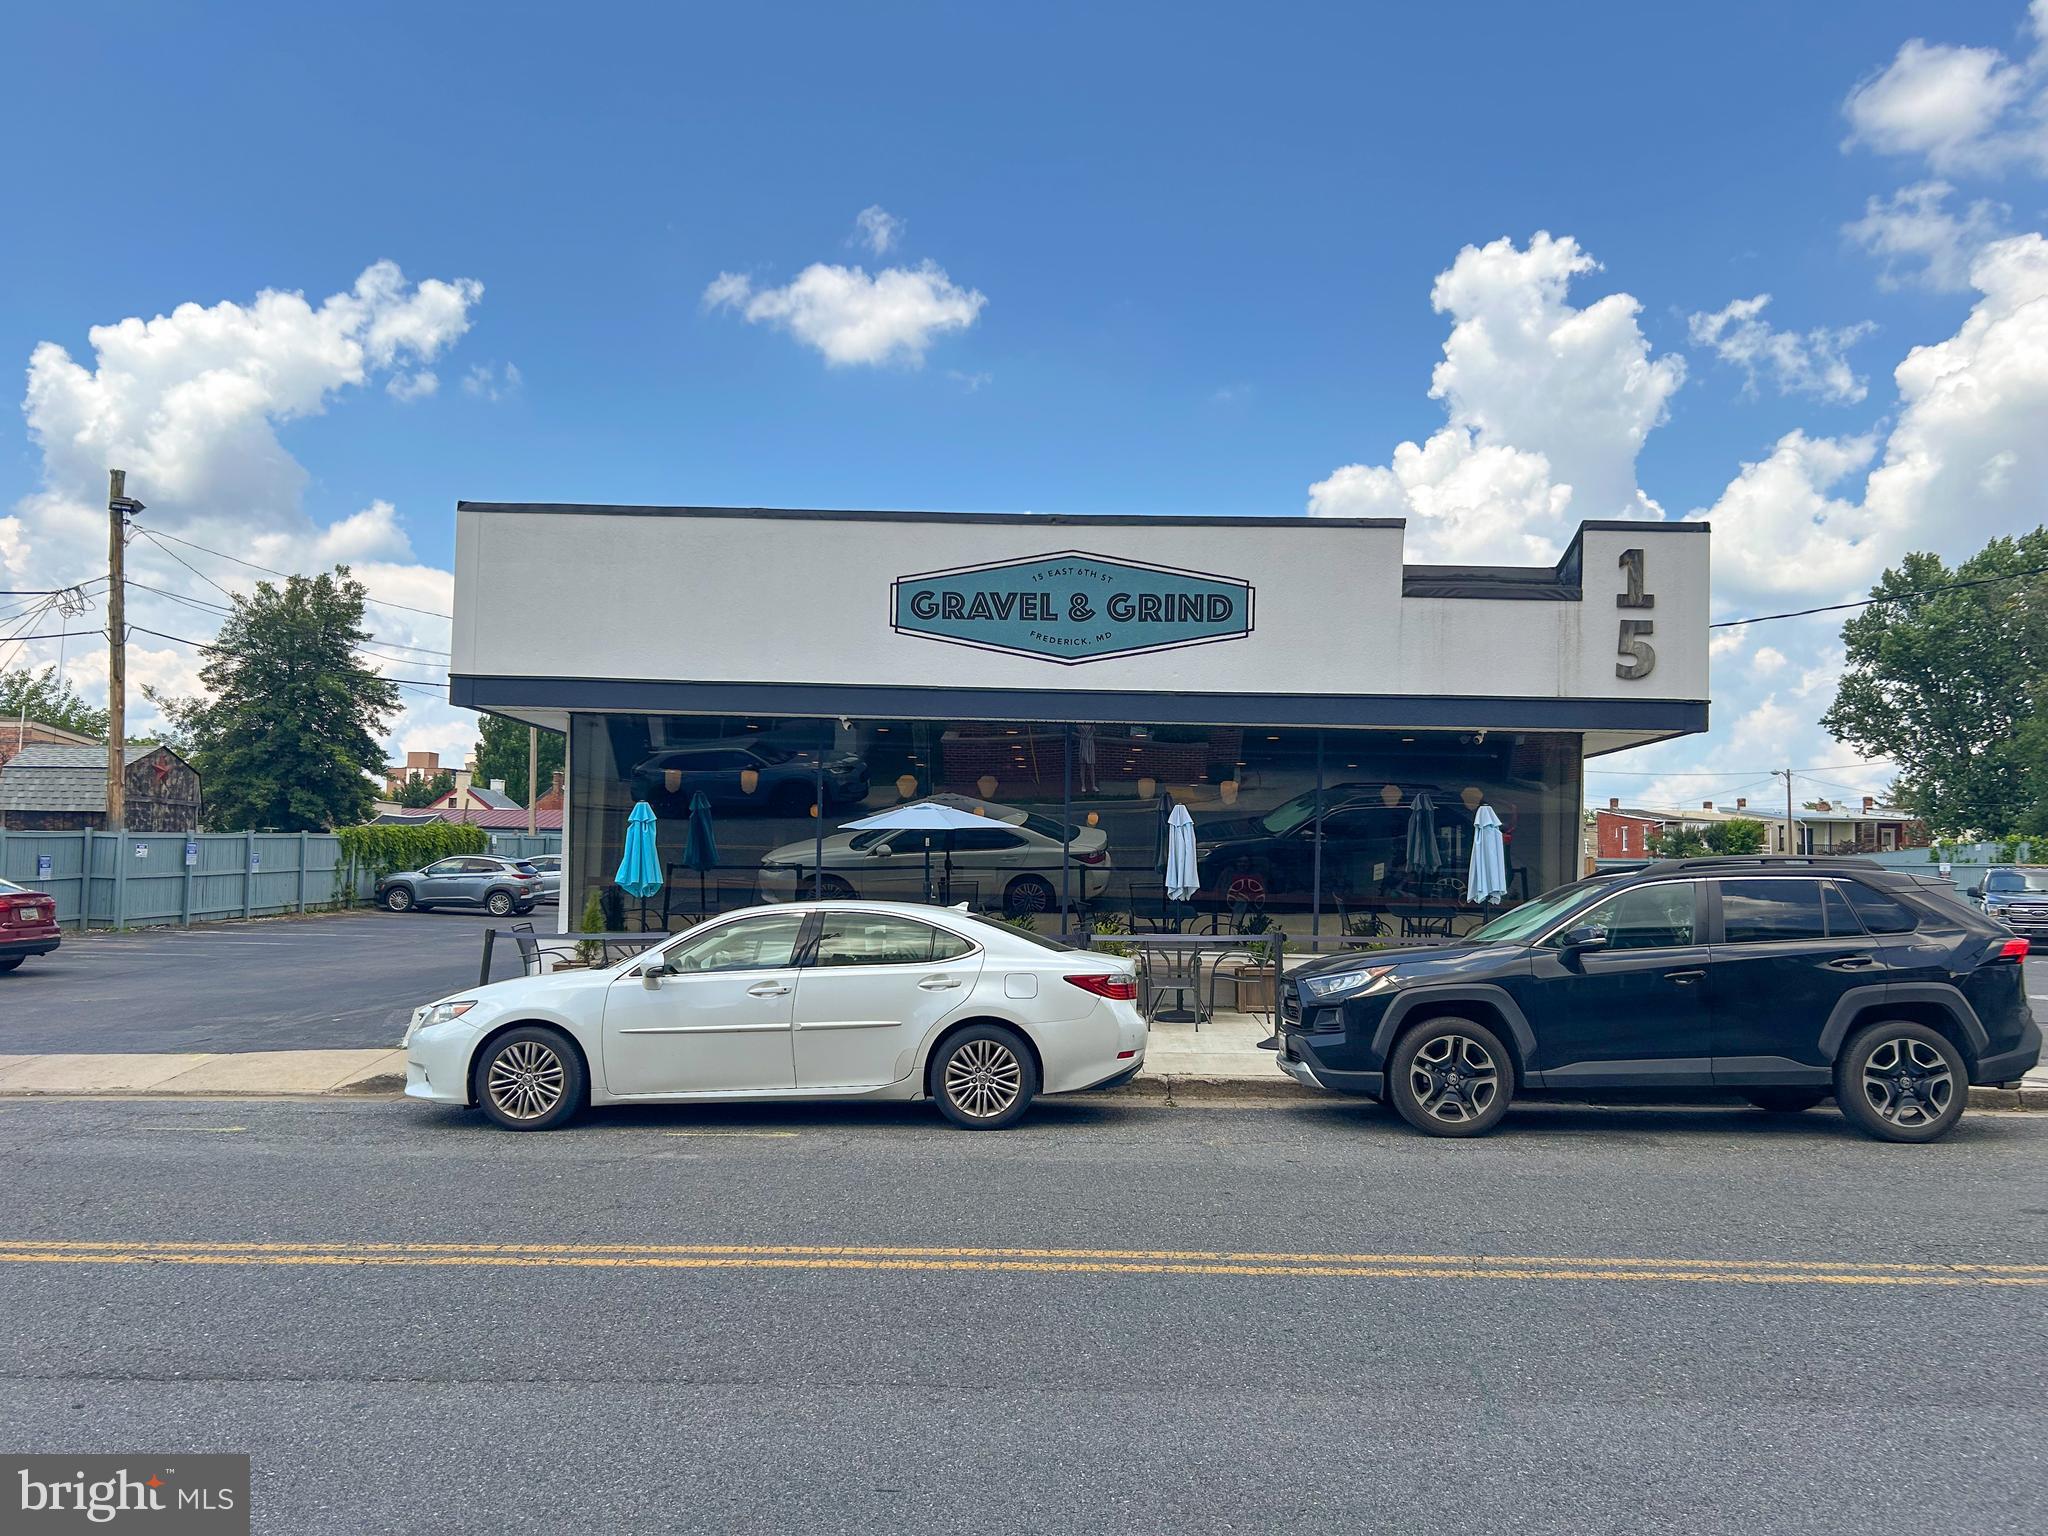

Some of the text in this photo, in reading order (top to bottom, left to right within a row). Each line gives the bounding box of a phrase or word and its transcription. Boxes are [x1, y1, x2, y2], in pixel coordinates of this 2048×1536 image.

[1032, 567, 1114, 584] 15 EAST 6TH ST
[910, 590, 1234, 624] GRAVEL & GRIND
[1029, 630, 1112, 646] FREDERICK, MD
